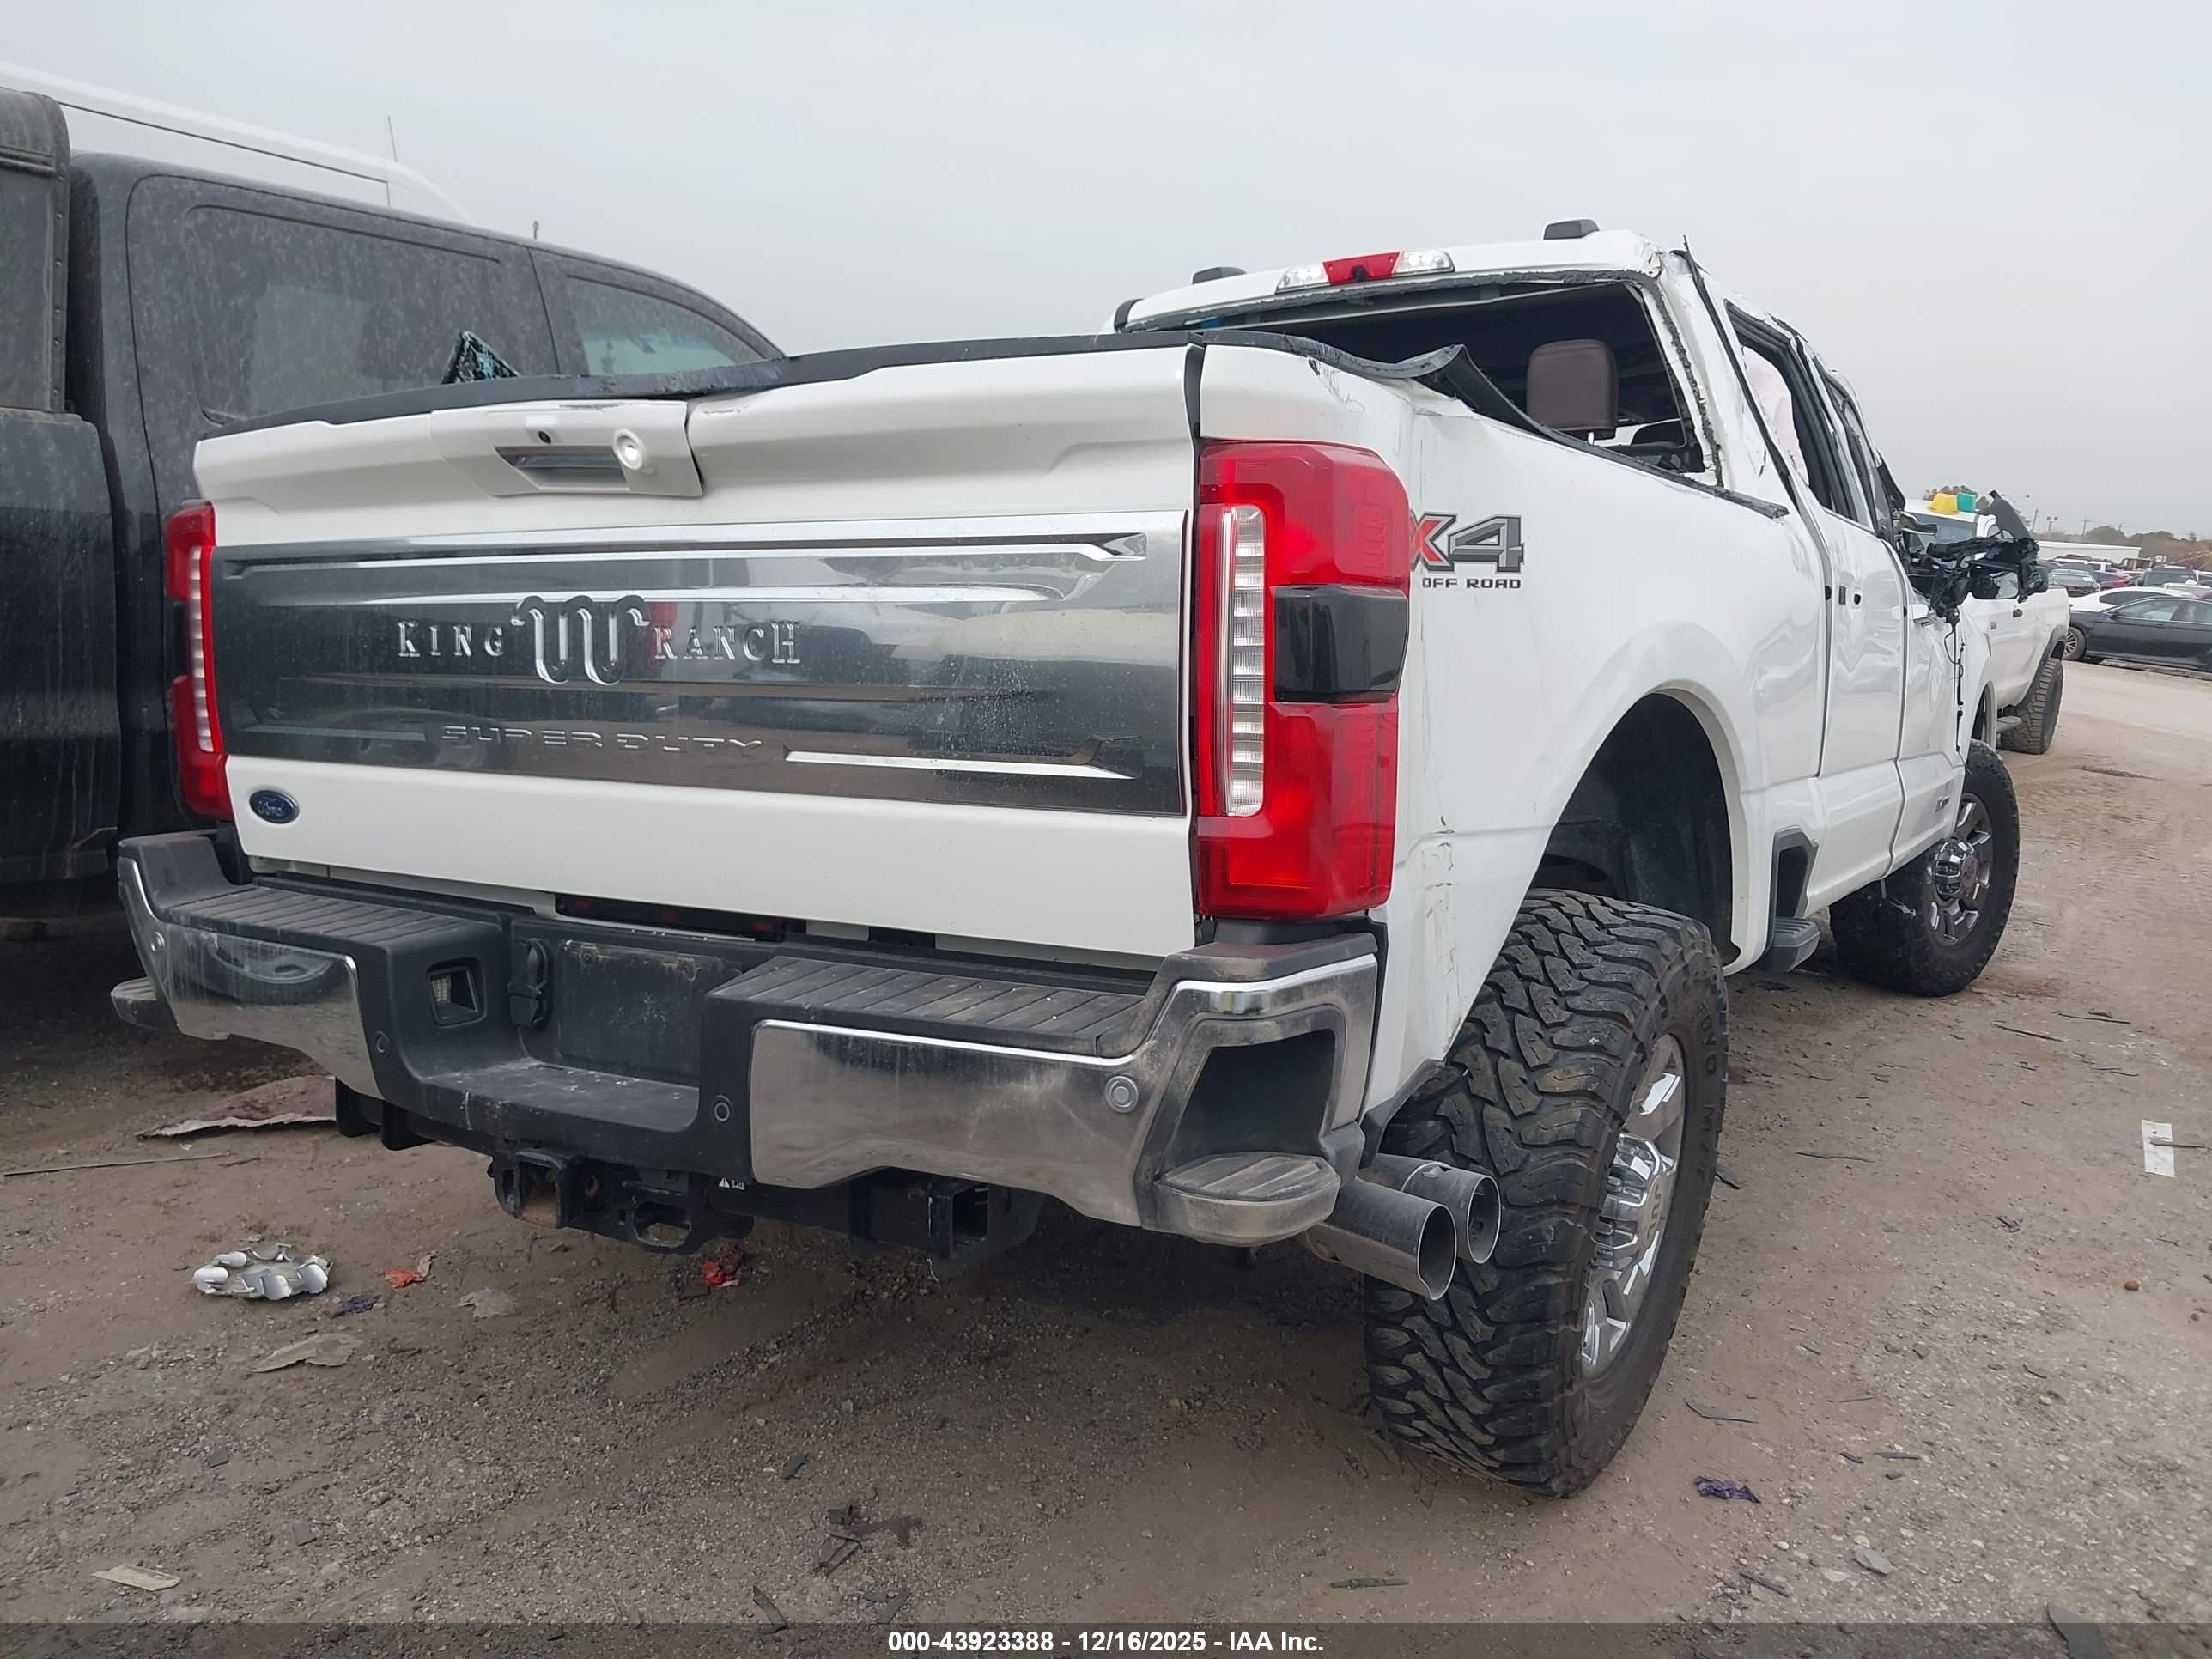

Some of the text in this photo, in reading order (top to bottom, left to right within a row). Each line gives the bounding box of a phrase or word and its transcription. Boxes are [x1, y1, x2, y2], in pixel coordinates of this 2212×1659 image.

[1422, 577, 1522, 589] OFF ROAD
[397, 620, 801, 665] KING RANCH
[441, 725, 763, 753] SUPER DUTY
